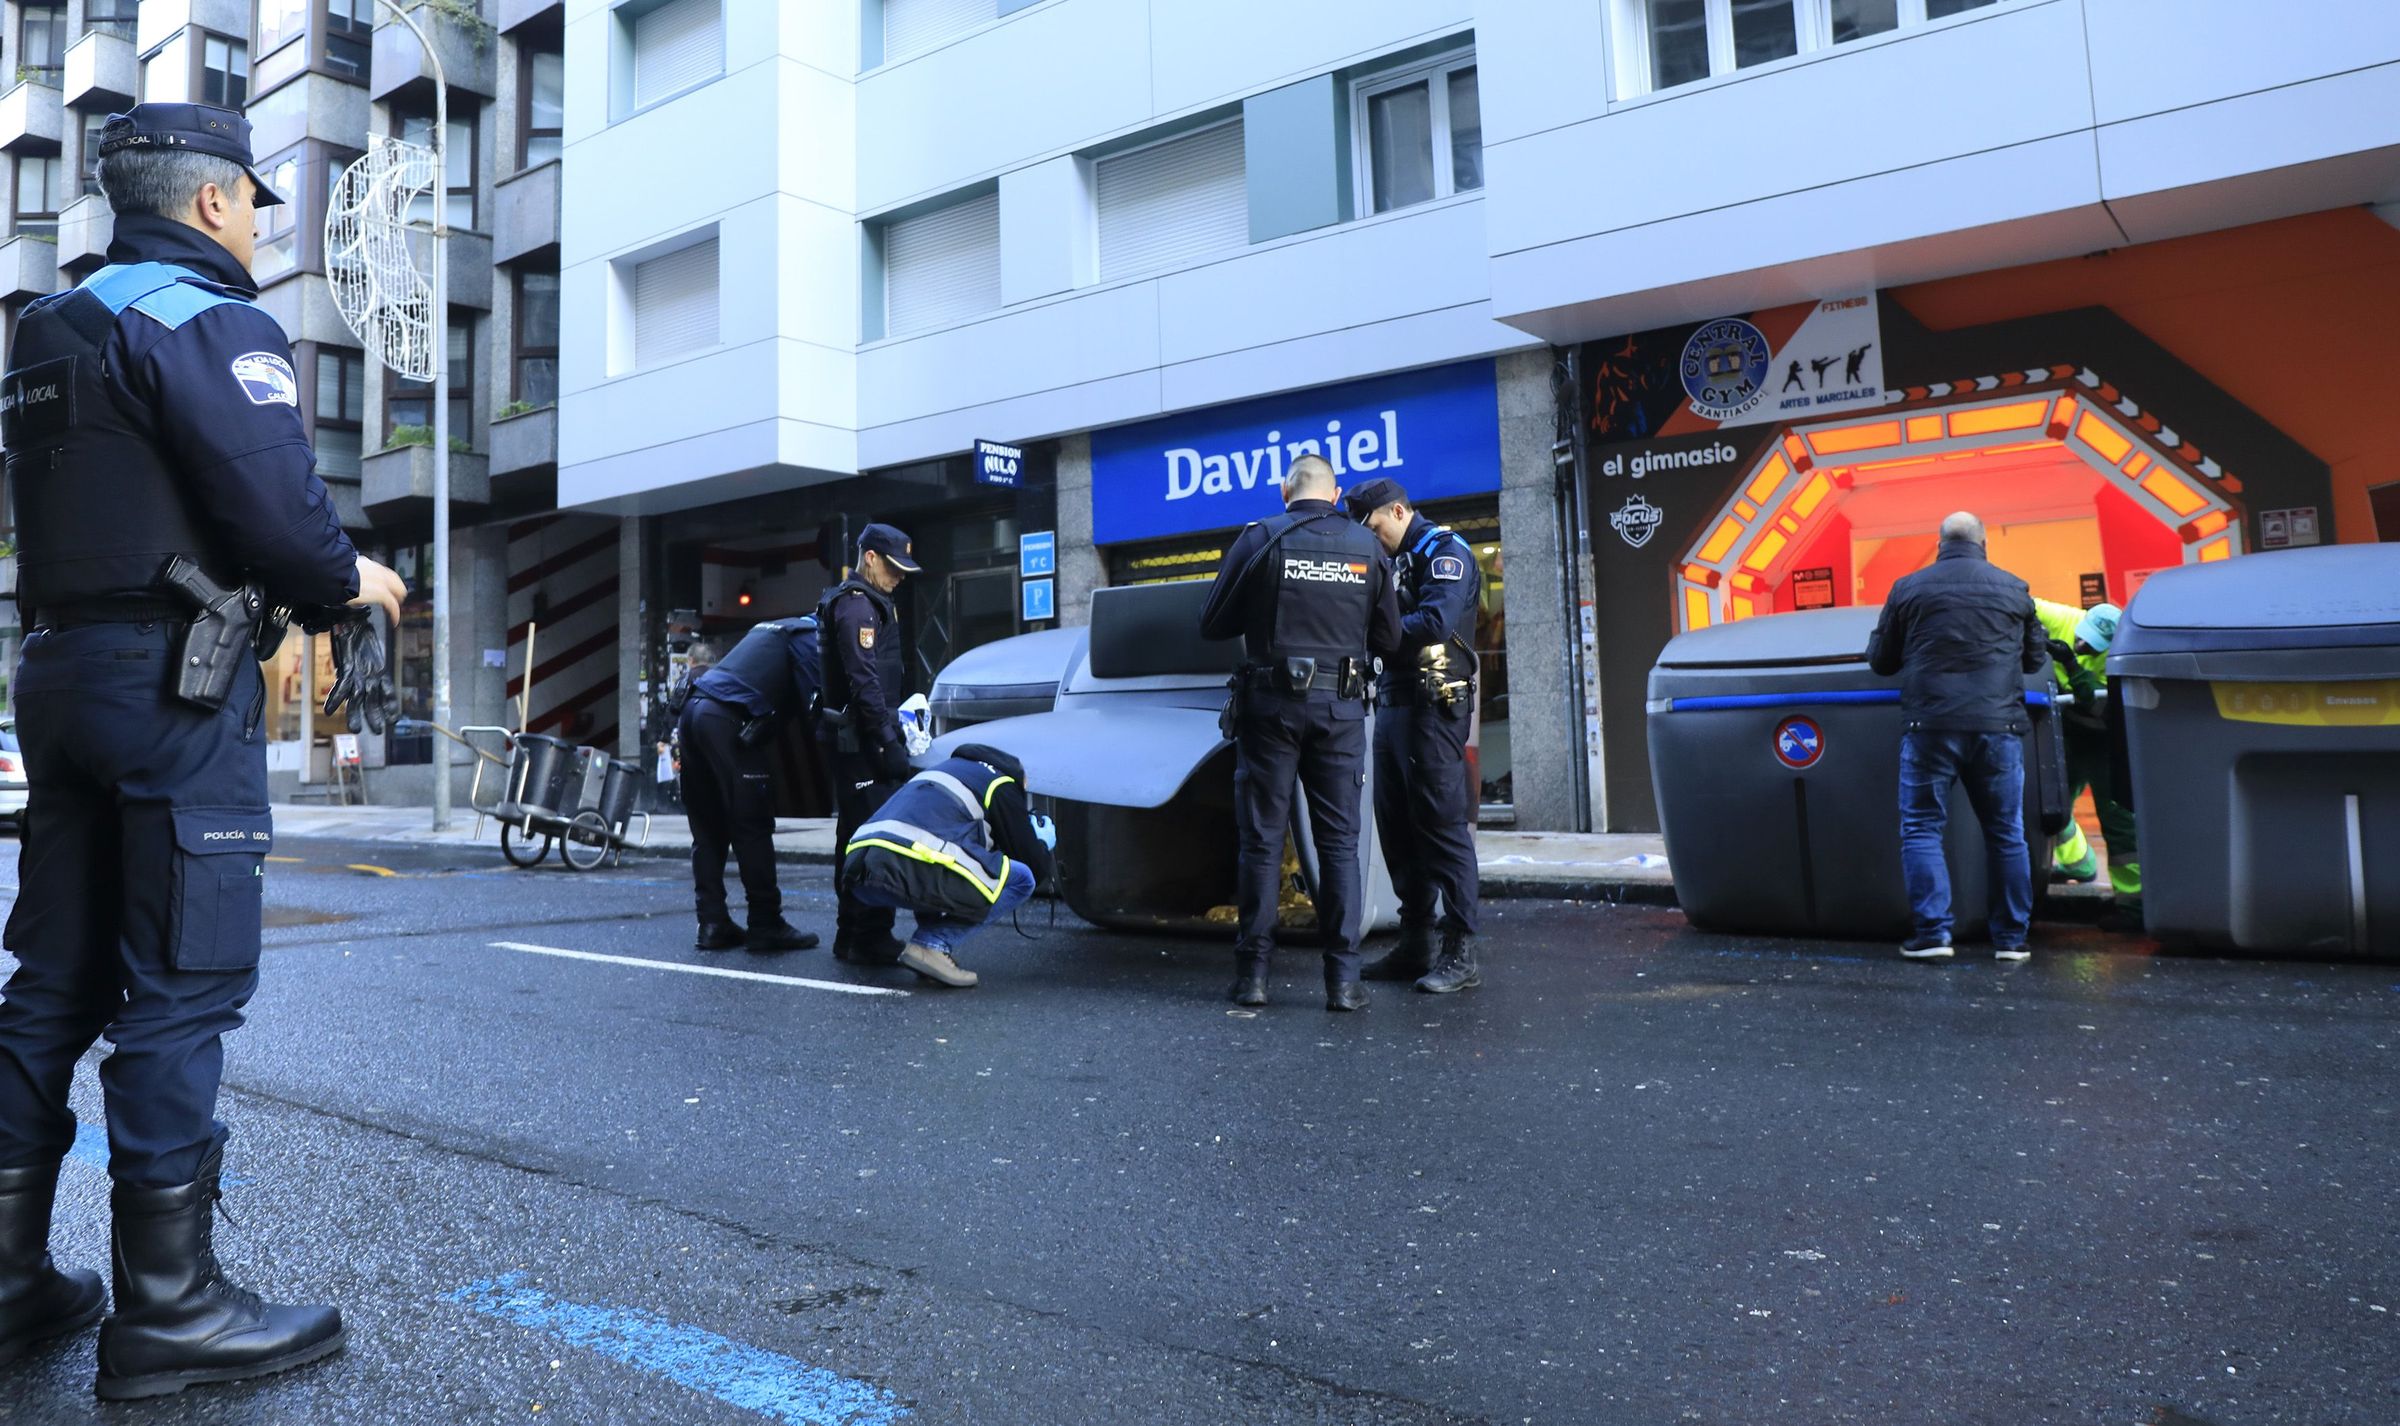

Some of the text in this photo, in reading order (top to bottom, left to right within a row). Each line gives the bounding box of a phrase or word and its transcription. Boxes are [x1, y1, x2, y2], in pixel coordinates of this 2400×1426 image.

[1822, 296, 1868, 312] FITNESS
[1684, 324, 1764, 378] CENTRAL
[26, 384, 59, 404] LOCAL
[1701, 378, 1755, 404] GYM
[1780, 387, 1876, 409] ARTES MARCIALES
[1697, 396, 1760, 419] SANTIAGO
[980, 441, 1022, 460] PENSION
[1602, 441, 1738, 479] el gimnasio
[984, 455, 1018, 477] NILO
[1611, 510, 1660, 526] FOCUS
[1284, 559, 1352, 573] POLICIA
[1284, 569, 1366, 585] NACIONAL
[203, 829, 246, 841] POLICÍA
